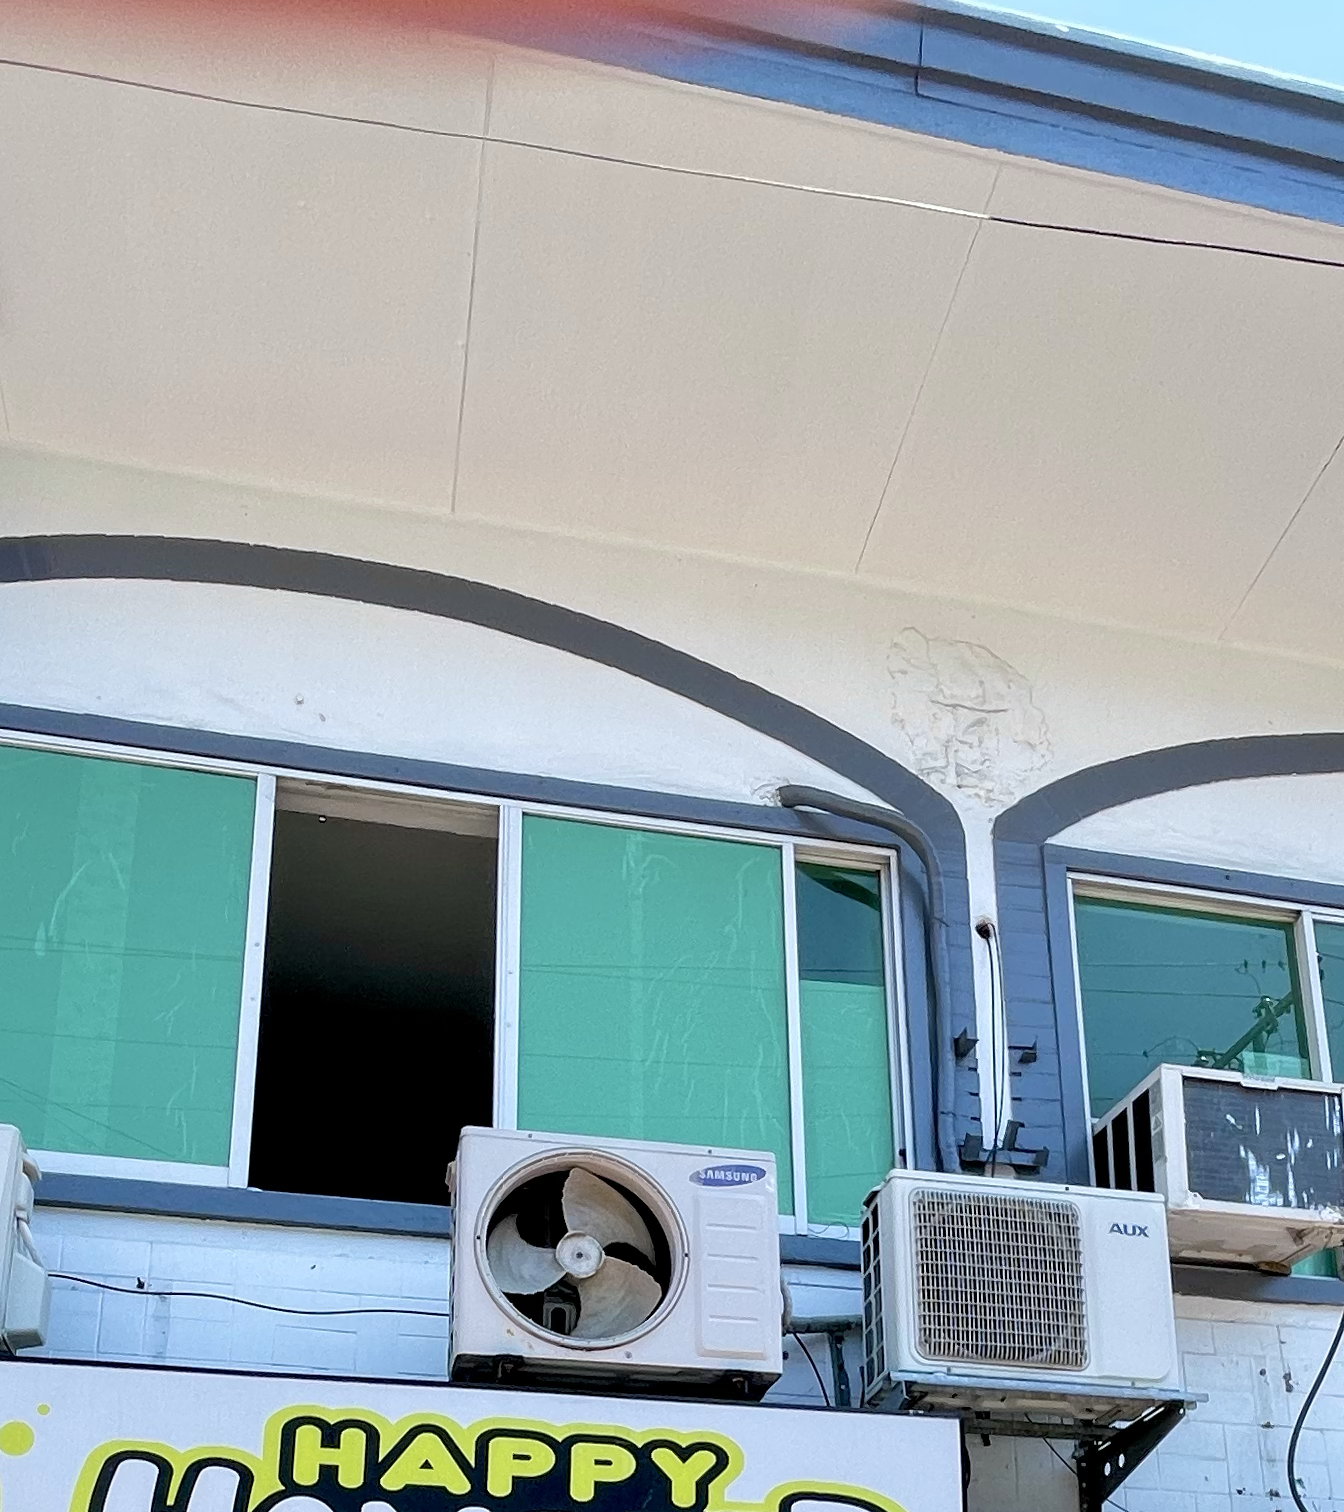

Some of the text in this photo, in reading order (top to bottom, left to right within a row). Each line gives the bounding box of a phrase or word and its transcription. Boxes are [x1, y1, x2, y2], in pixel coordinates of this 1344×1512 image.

[698, 1169, 758, 1183] SAMSUNG
[1108, 1222, 1150, 1239] AUX
[286, 1420, 722, 1511] HAPPY
